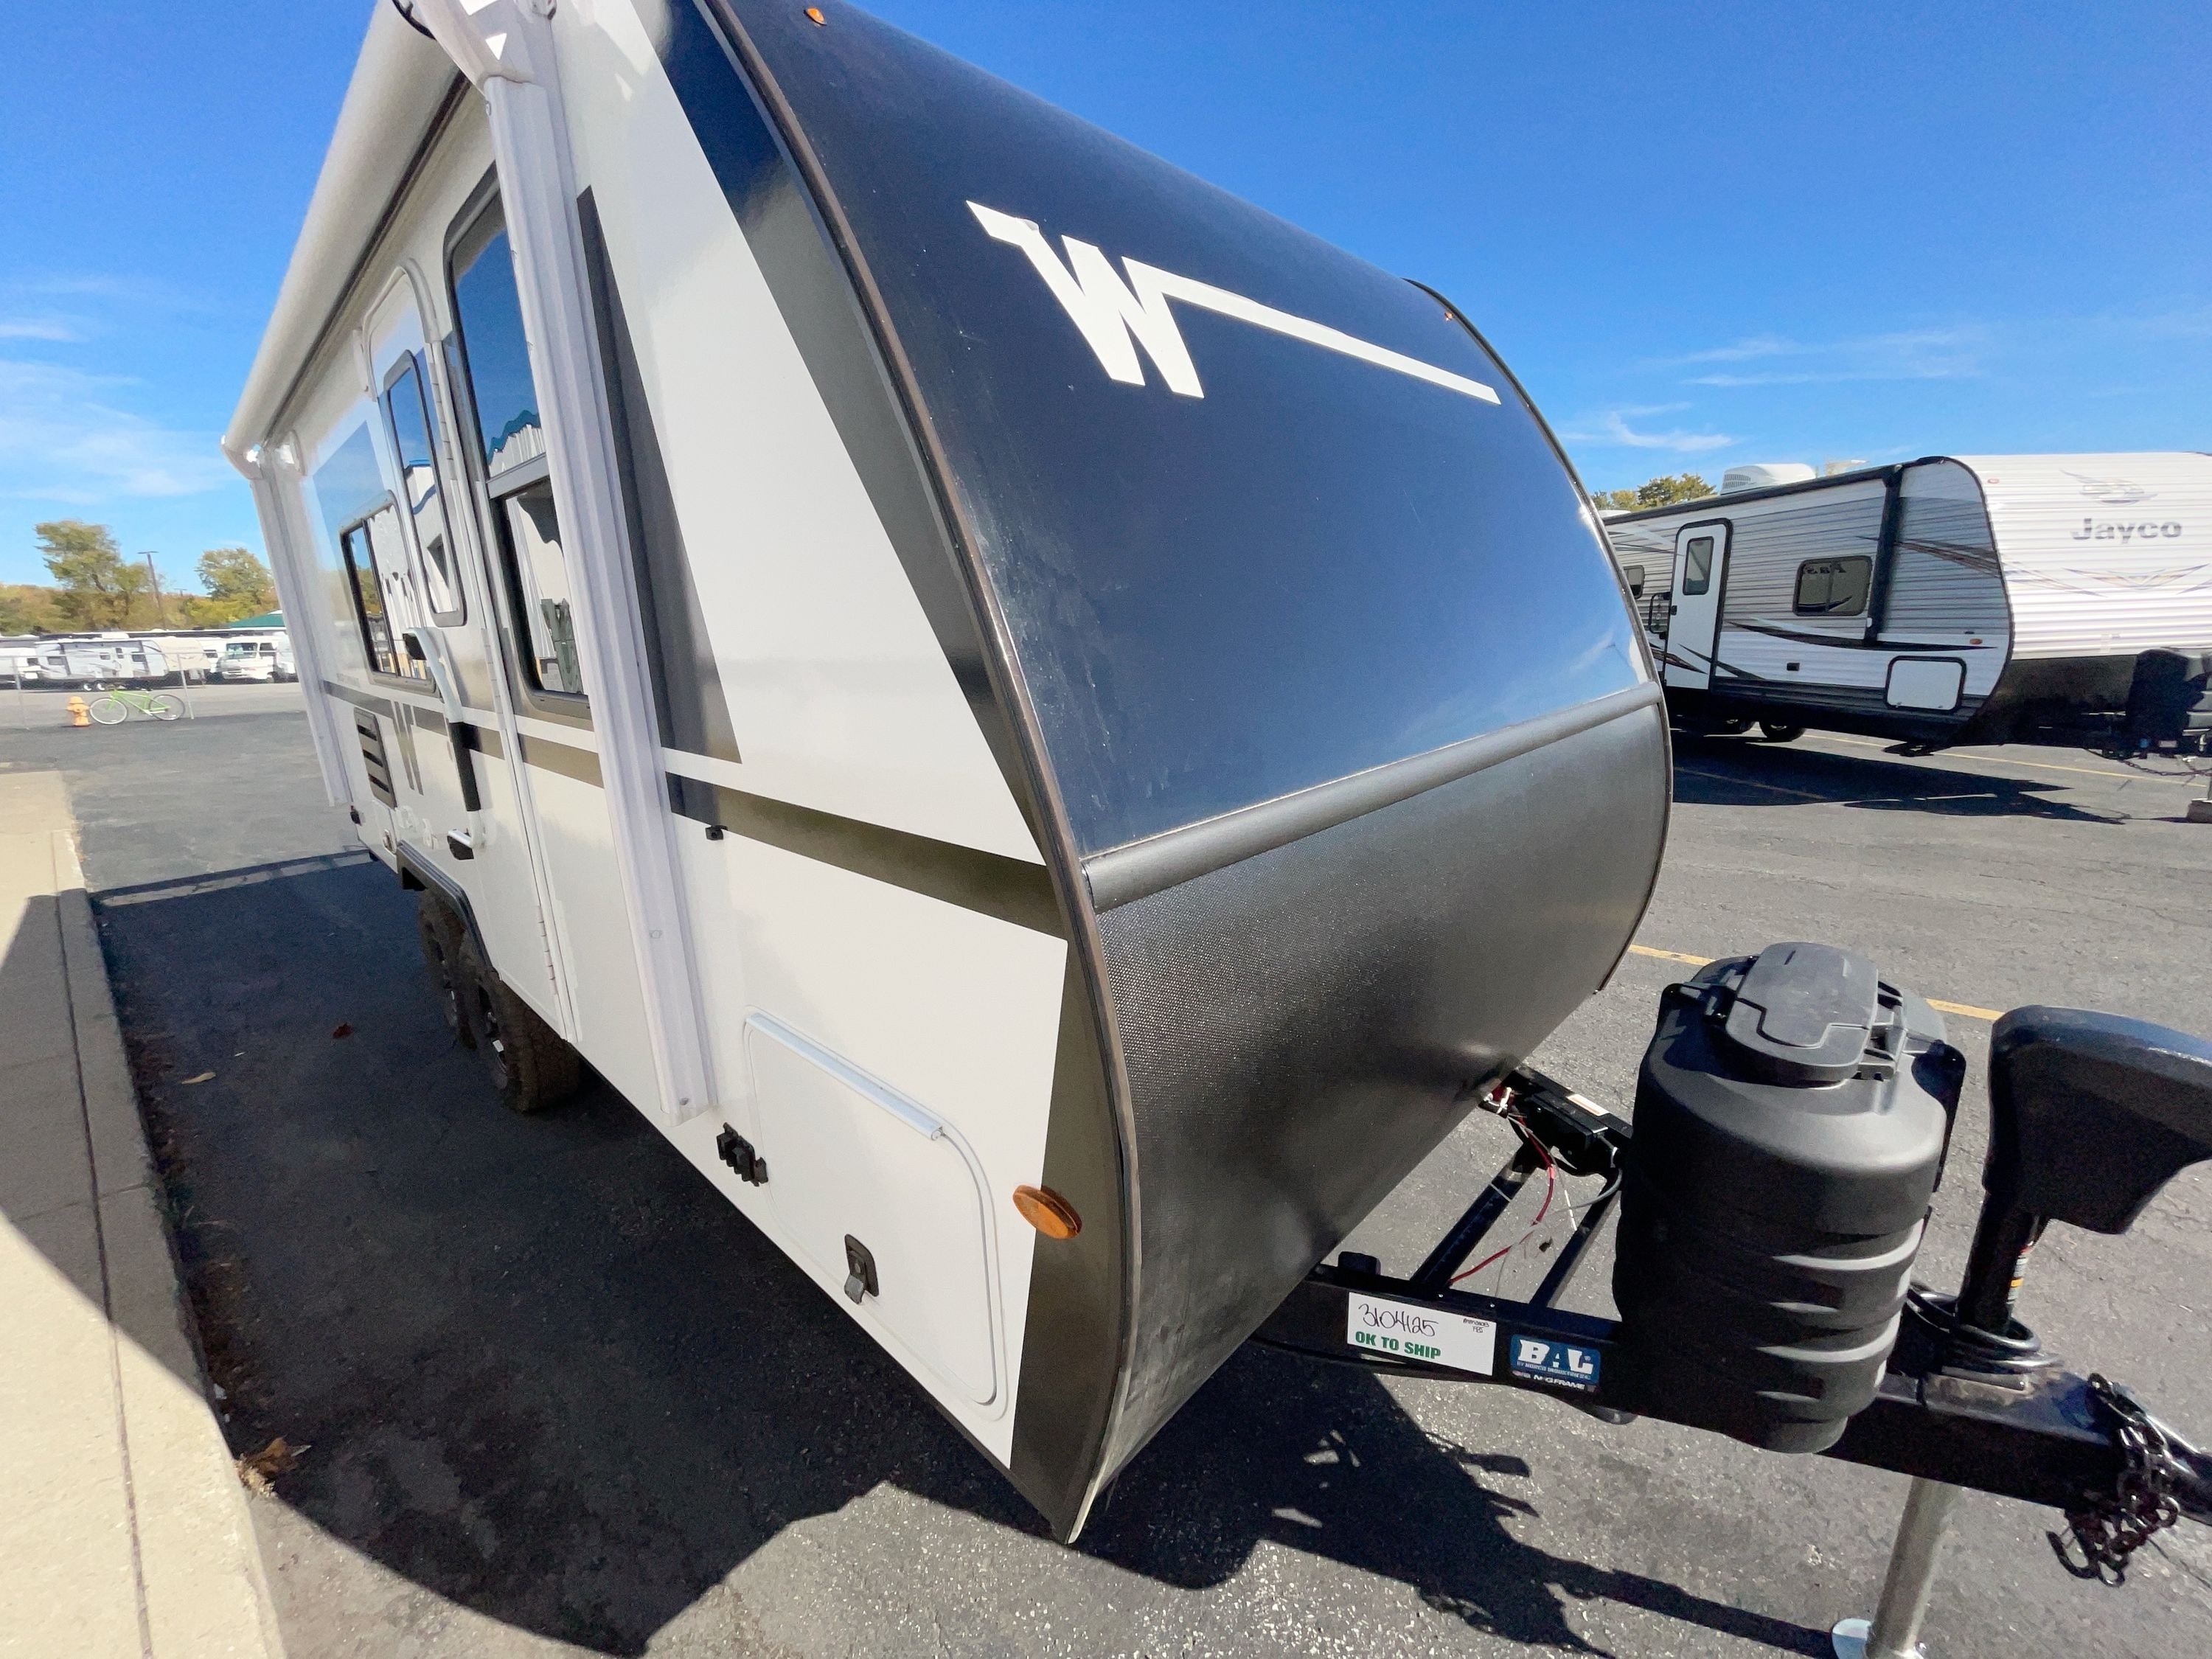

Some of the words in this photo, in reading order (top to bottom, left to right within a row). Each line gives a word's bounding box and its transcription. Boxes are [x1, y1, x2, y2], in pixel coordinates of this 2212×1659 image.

[2070, 518, 2182, 543] Jayco
[1358, 1303, 1439, 1337] 3104125
[1355, 1331, 1377, 1346] OK
[1381, 1336, 1399, 1351] TO
[1404, 1342, 1441, 1359] SHIP
[1517, 1339, 1593, 1374] BAL
